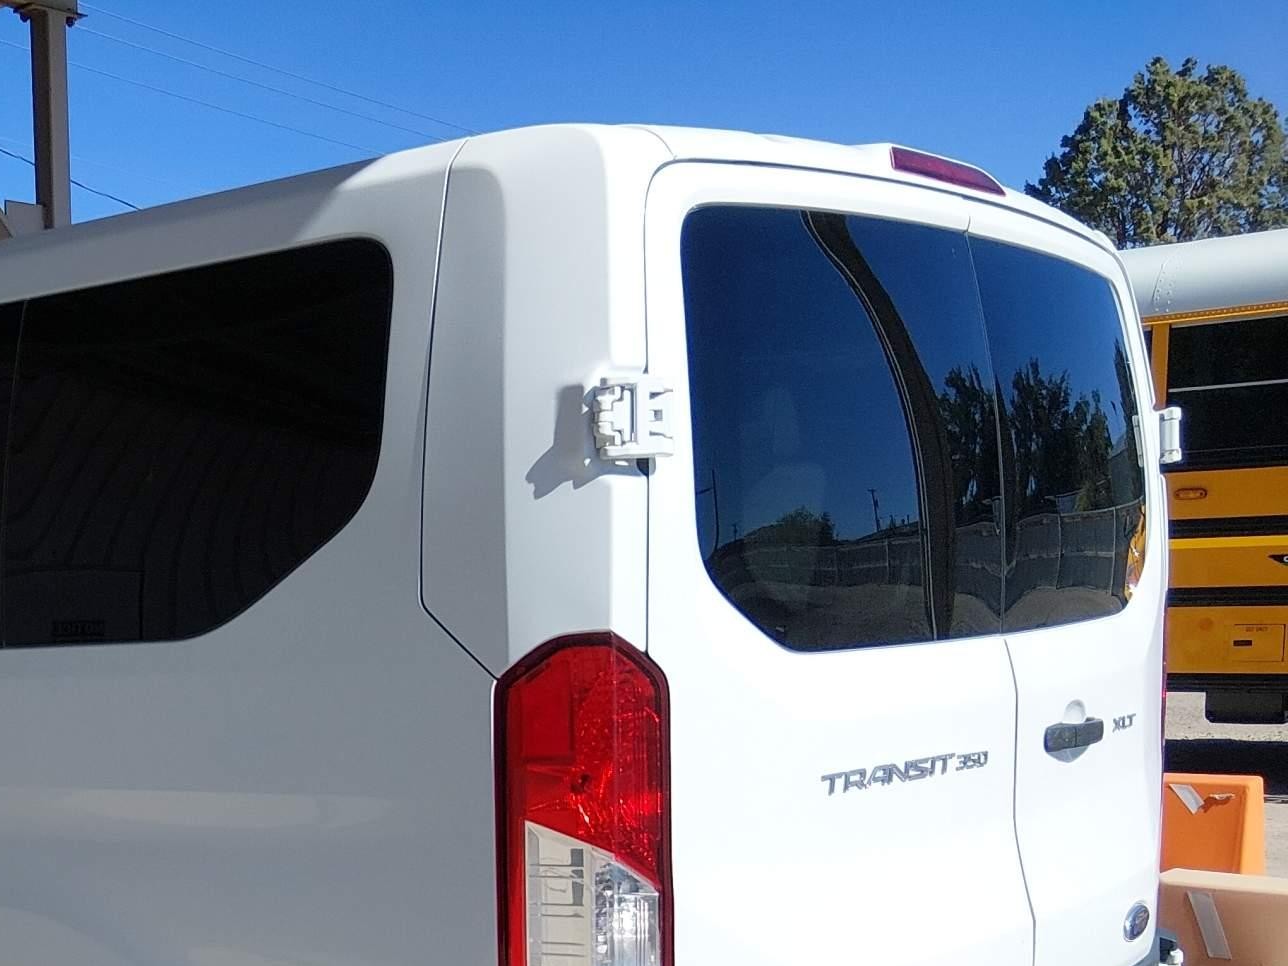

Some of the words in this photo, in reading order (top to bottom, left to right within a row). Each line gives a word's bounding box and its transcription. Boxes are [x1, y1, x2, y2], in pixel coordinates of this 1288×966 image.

[1112, 713, 1137, 733] XLT
[821, 753, 956, 796] TRANSIT
[955, 751, 988, 771] 350
